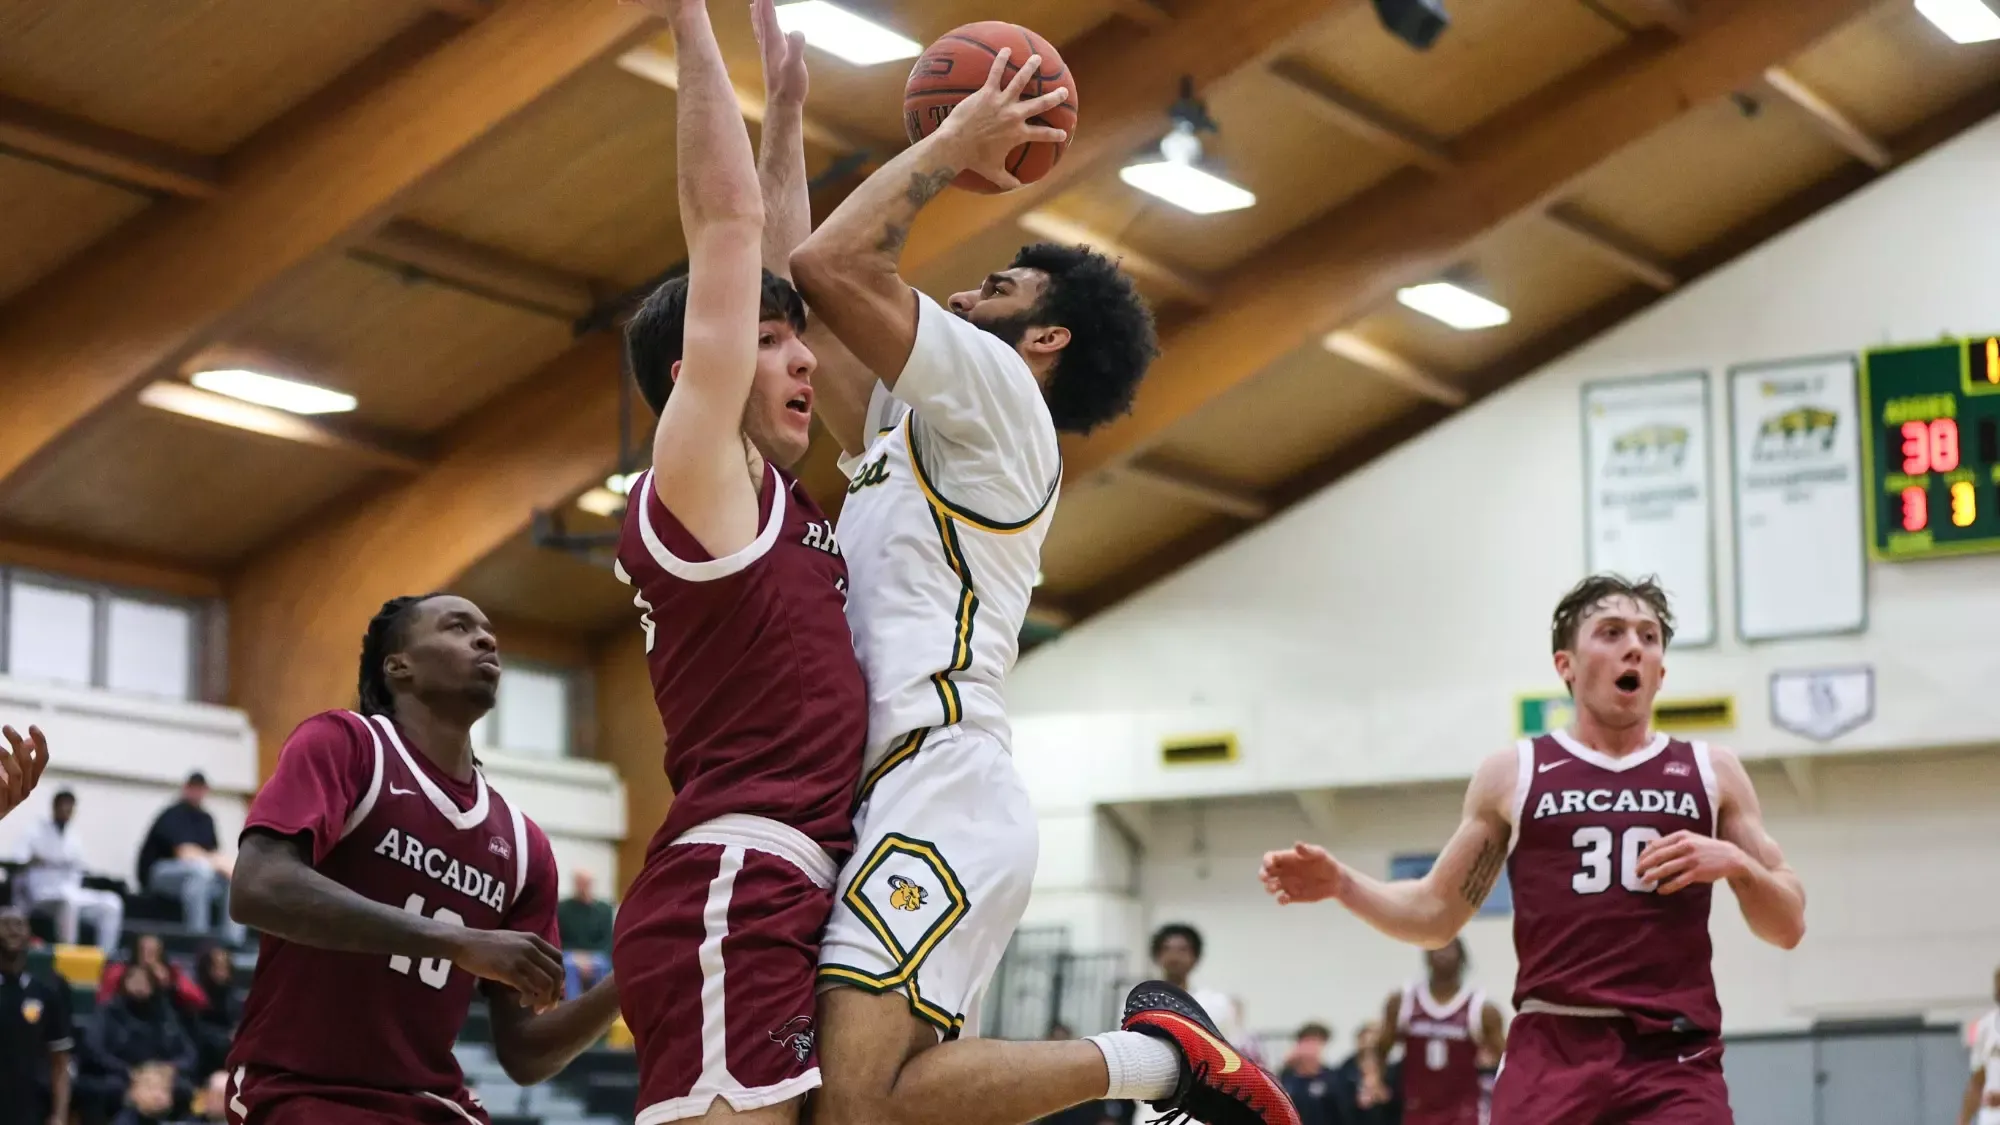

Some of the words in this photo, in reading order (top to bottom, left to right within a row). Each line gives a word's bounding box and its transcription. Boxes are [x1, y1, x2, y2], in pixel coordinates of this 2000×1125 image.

[1533, 788, 1700, 820] ARCADIA
[374, 827, 506, 914] ARCADIA
[1571, 825, 1660, 894] 30
